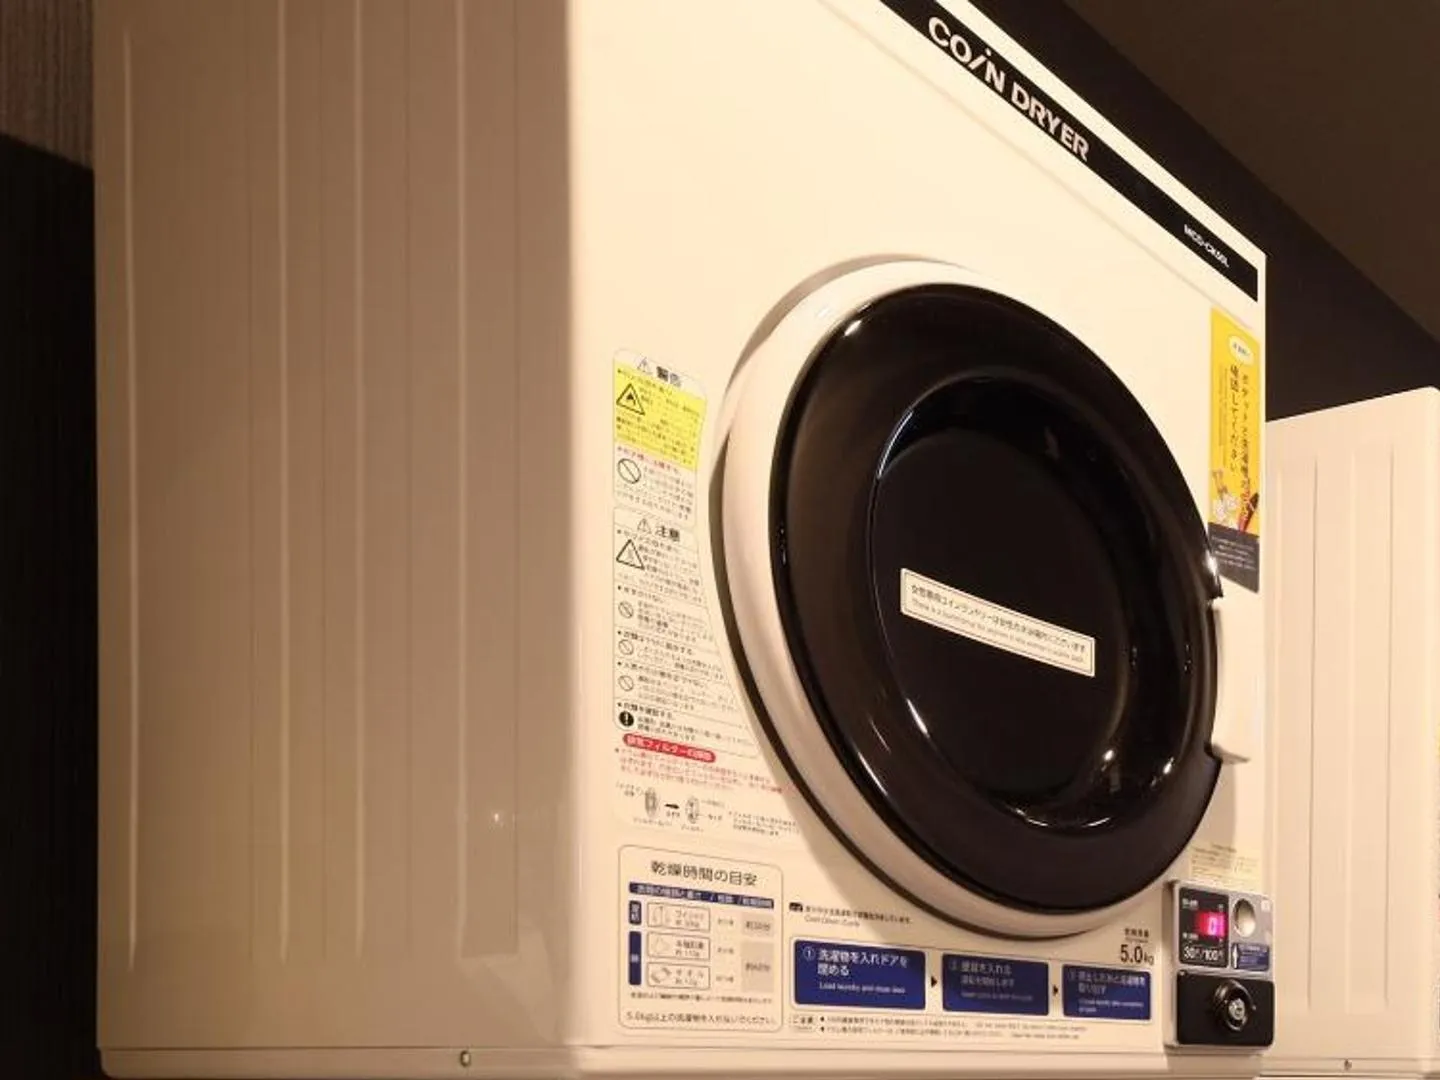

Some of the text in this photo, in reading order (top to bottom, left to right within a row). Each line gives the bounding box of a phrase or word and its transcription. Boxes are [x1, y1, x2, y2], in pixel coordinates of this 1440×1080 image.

[928, 16, 1090, 162] COIN DRYER
[655, 525, 681, 542] 注意
[650, 860, 758, 886] 乾燥時間の目安
[1120, 943, 1154, 966] 5.0kg
